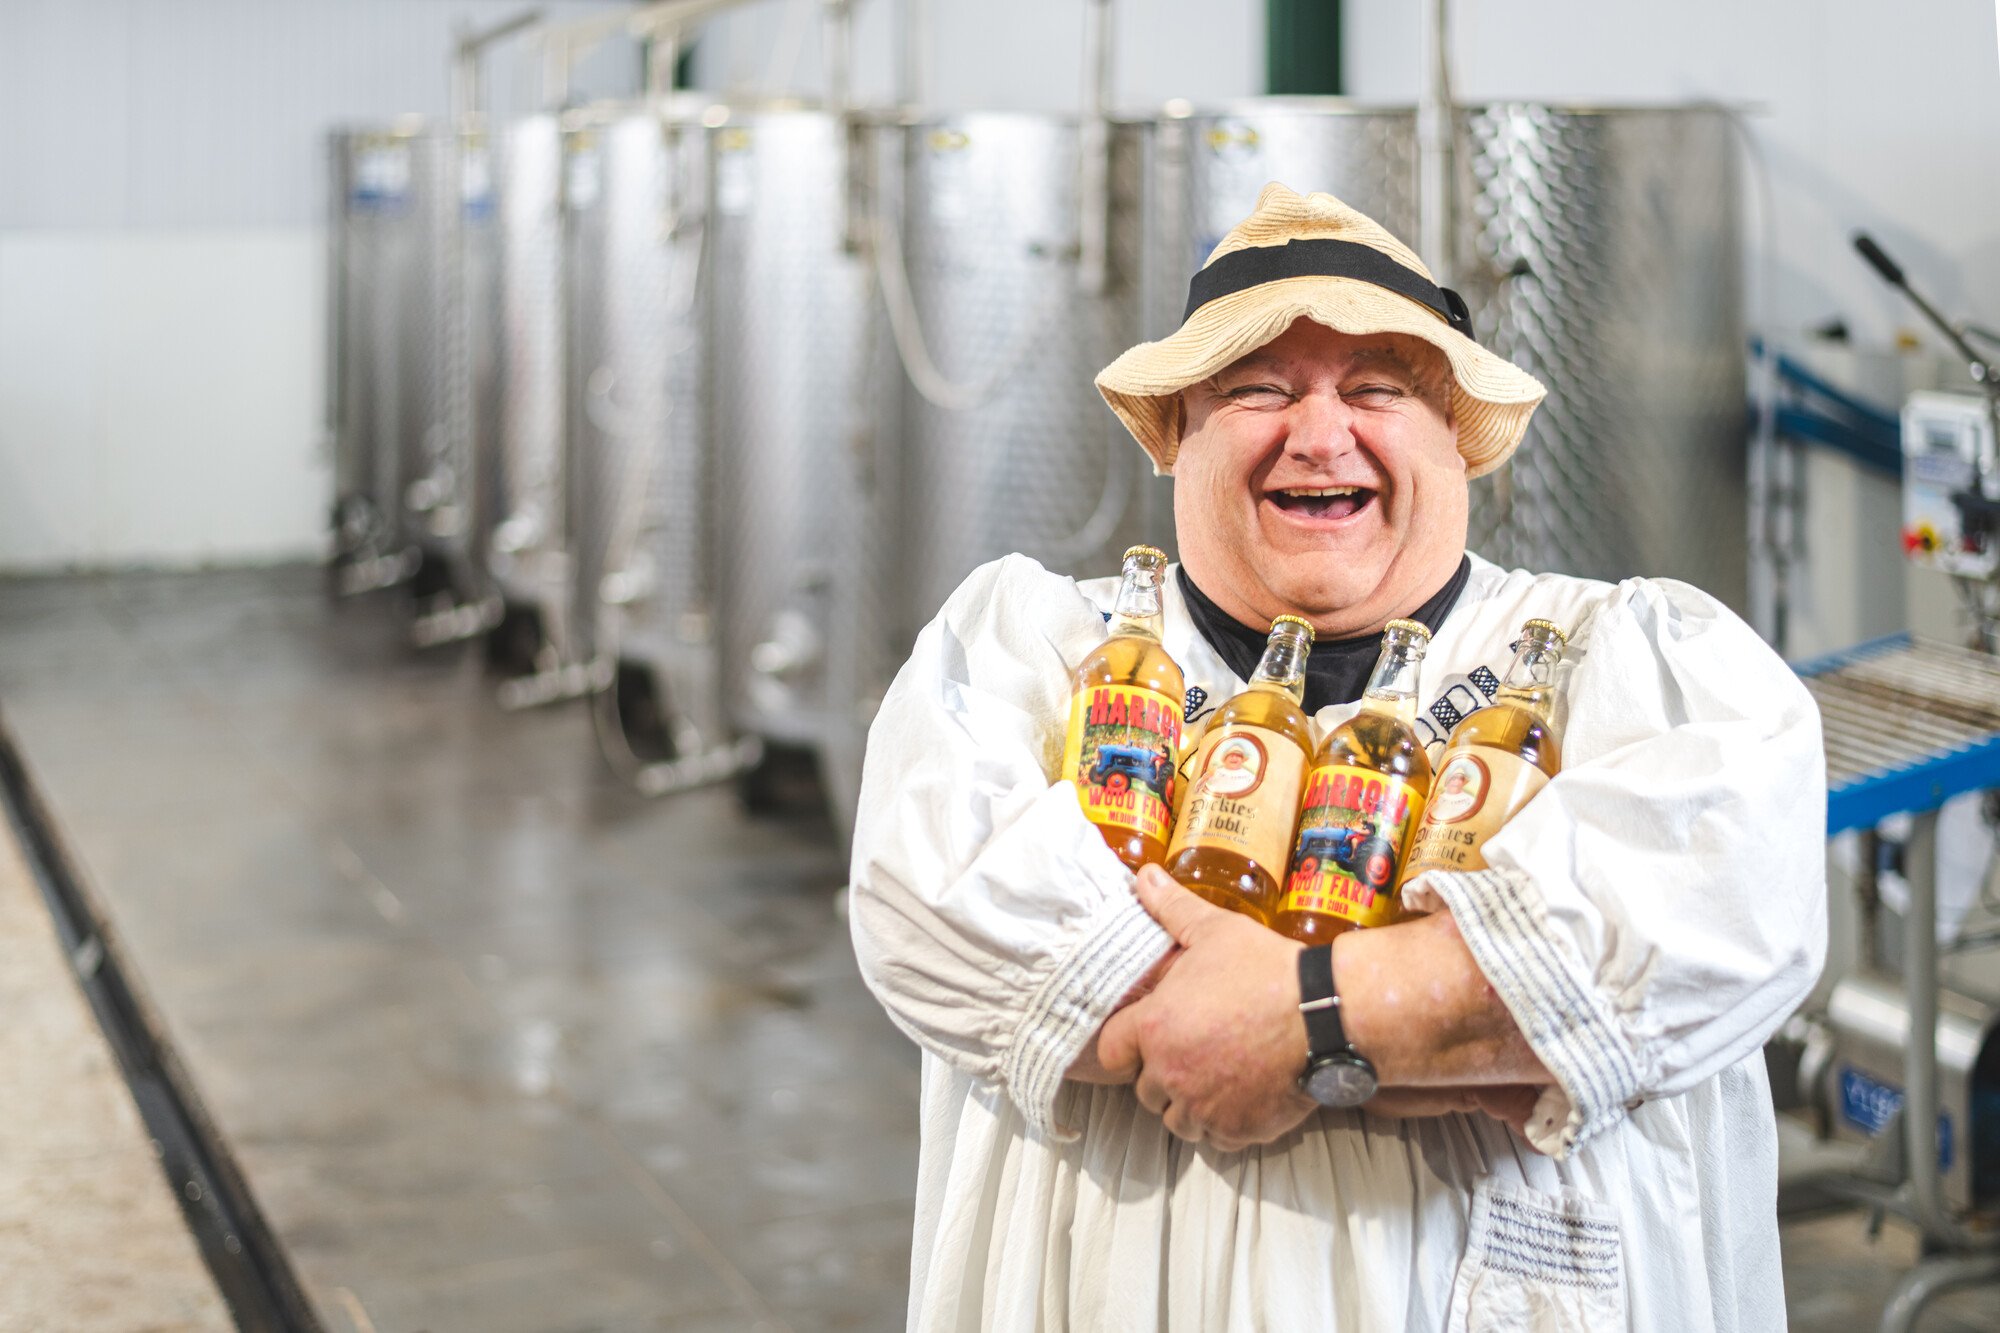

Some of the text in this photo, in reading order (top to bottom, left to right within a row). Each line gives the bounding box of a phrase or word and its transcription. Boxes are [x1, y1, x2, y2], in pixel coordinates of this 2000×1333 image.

[1089, 688, 1182, 752] HARROW
[1089, 786, 1135, 810] WOOD
[1303, 770, 1409, 826] HARROW
[1108, 810, 1138, 826] MEDIUM
[1288, 870, 1376, 909] WOOD FARM
[1327, 898, 1349, 915] CIDER
